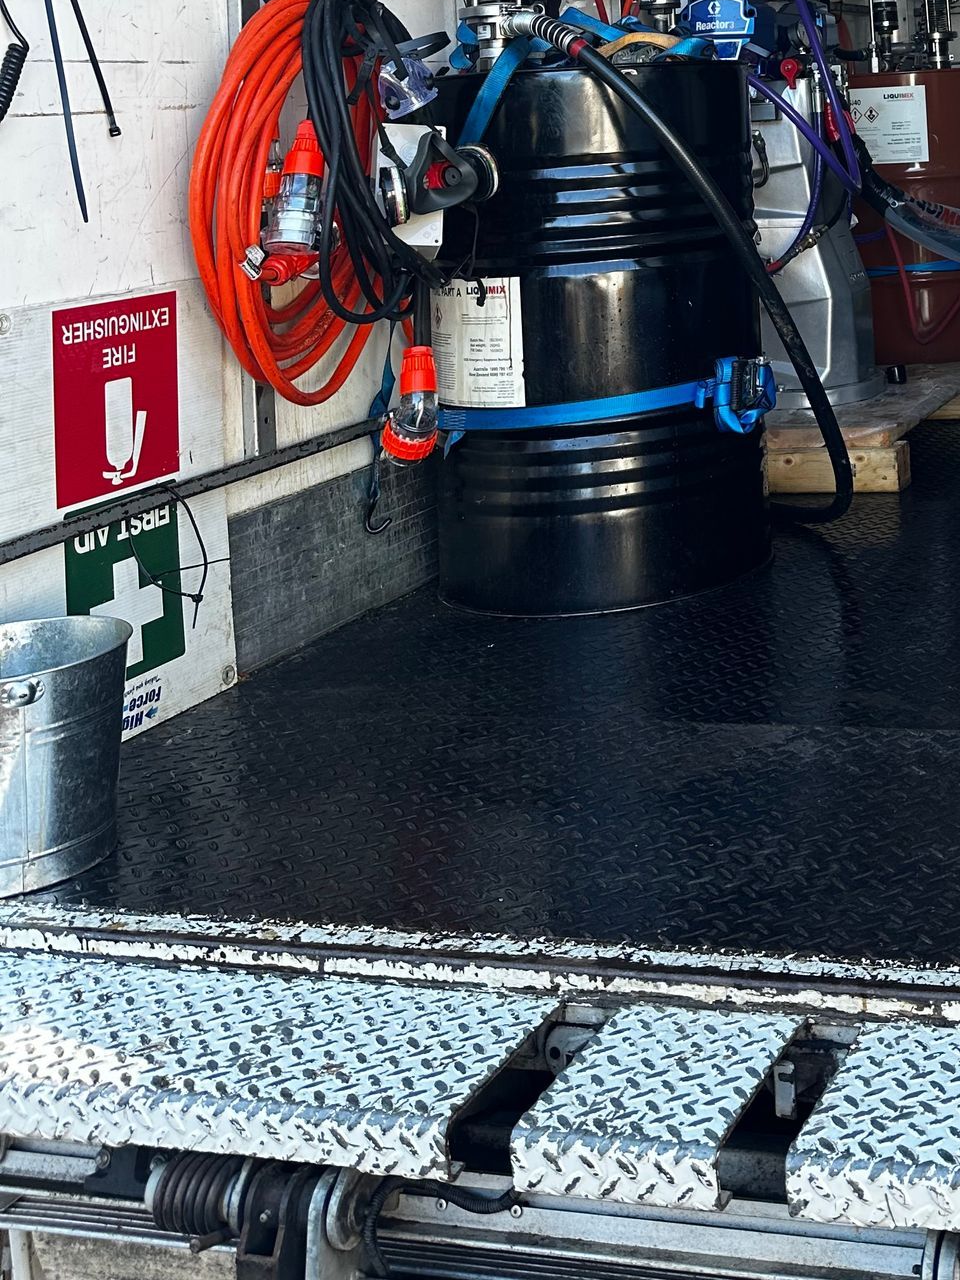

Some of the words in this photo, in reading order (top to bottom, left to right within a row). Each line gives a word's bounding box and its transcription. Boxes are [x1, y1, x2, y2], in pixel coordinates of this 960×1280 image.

[456, 287, 462, 297] A
[466, 285, 506, 296] LIQIMIX
[62, 307, 171, 346] EXTINGUISHER
[102, 343, 137, 369] FIRE
[117, 504, 171, 542] FIRST
[74, 525, 109, 555] AID
[129, 685, 162, 712] Force
[123, 710, 144, 731] Hig
